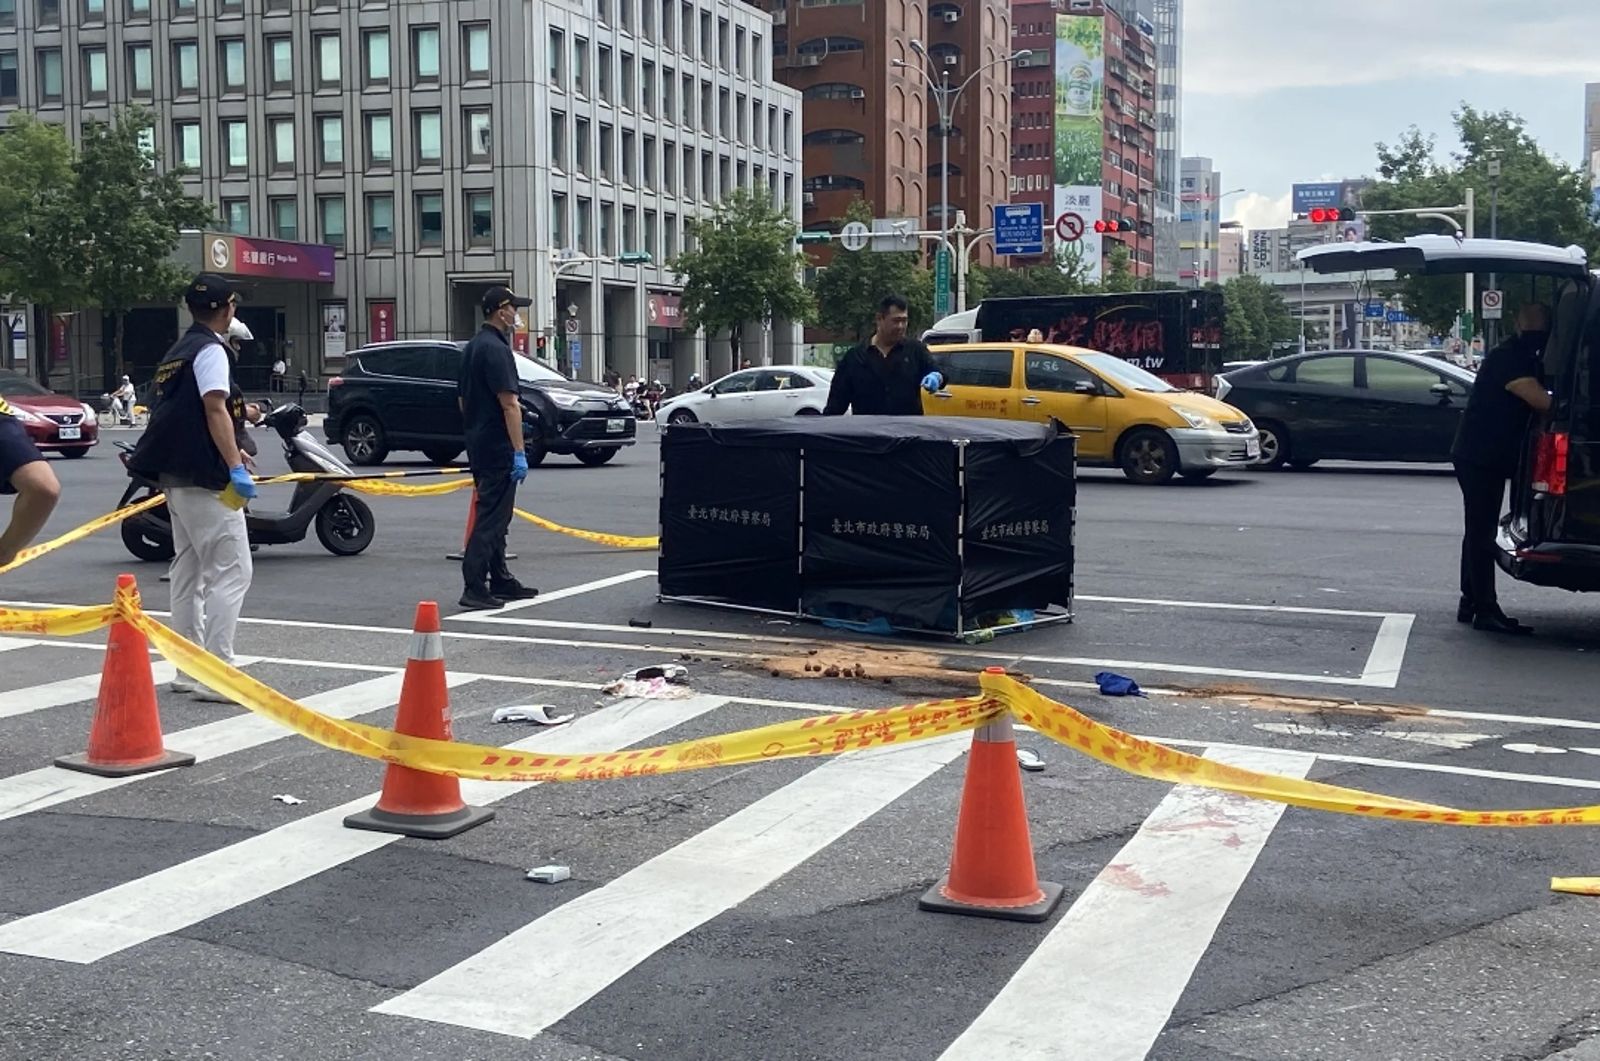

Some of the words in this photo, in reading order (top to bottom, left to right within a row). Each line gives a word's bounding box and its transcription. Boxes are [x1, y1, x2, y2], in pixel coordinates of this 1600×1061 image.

[1064, 195, 1090, 206] 淡麗
[688, 504, 771, 527] 臺北市政府警察局
[832, 518, 930, 540] 臺北市政府警察局
[981, 519, 1049, 540] 臺北市政府警察局
